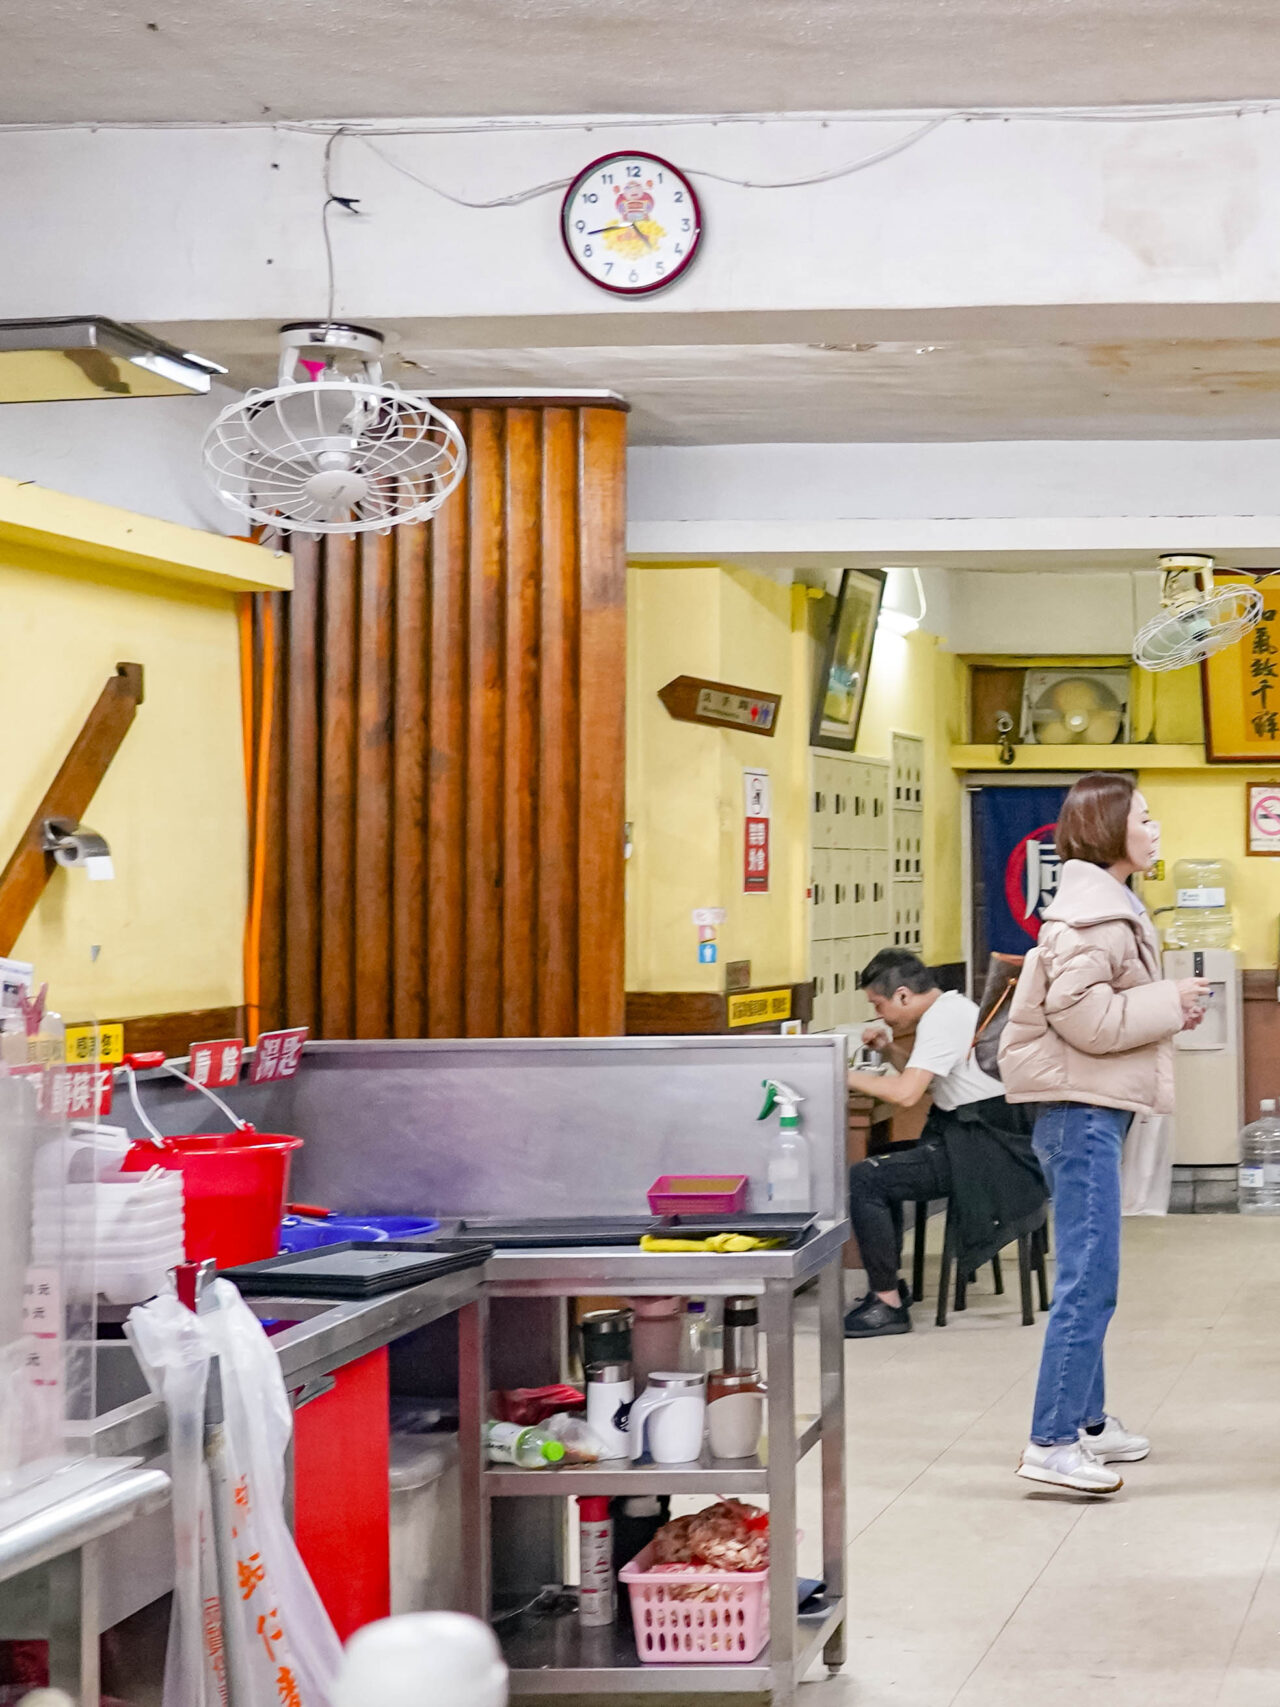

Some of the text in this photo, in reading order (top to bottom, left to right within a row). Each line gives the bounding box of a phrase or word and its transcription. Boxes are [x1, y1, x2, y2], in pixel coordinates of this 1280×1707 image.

[626, 166, 641, 178] 12
[658, 173, 663, 184] 1
[602, 174, 614, 184] 11
[582, 193, 598, 203] 10
[674, 191, 683, 203] 2
[575, 219, 586, 233] 9
[681, 218, 690, 232] 3
[583, 244, 593, 258] 8
[674, 243, 683, 256] 4
[604, 262, 614, 276] 7
[656, 262, 665, 275] 5
[628, 269, 639, 283] 6
